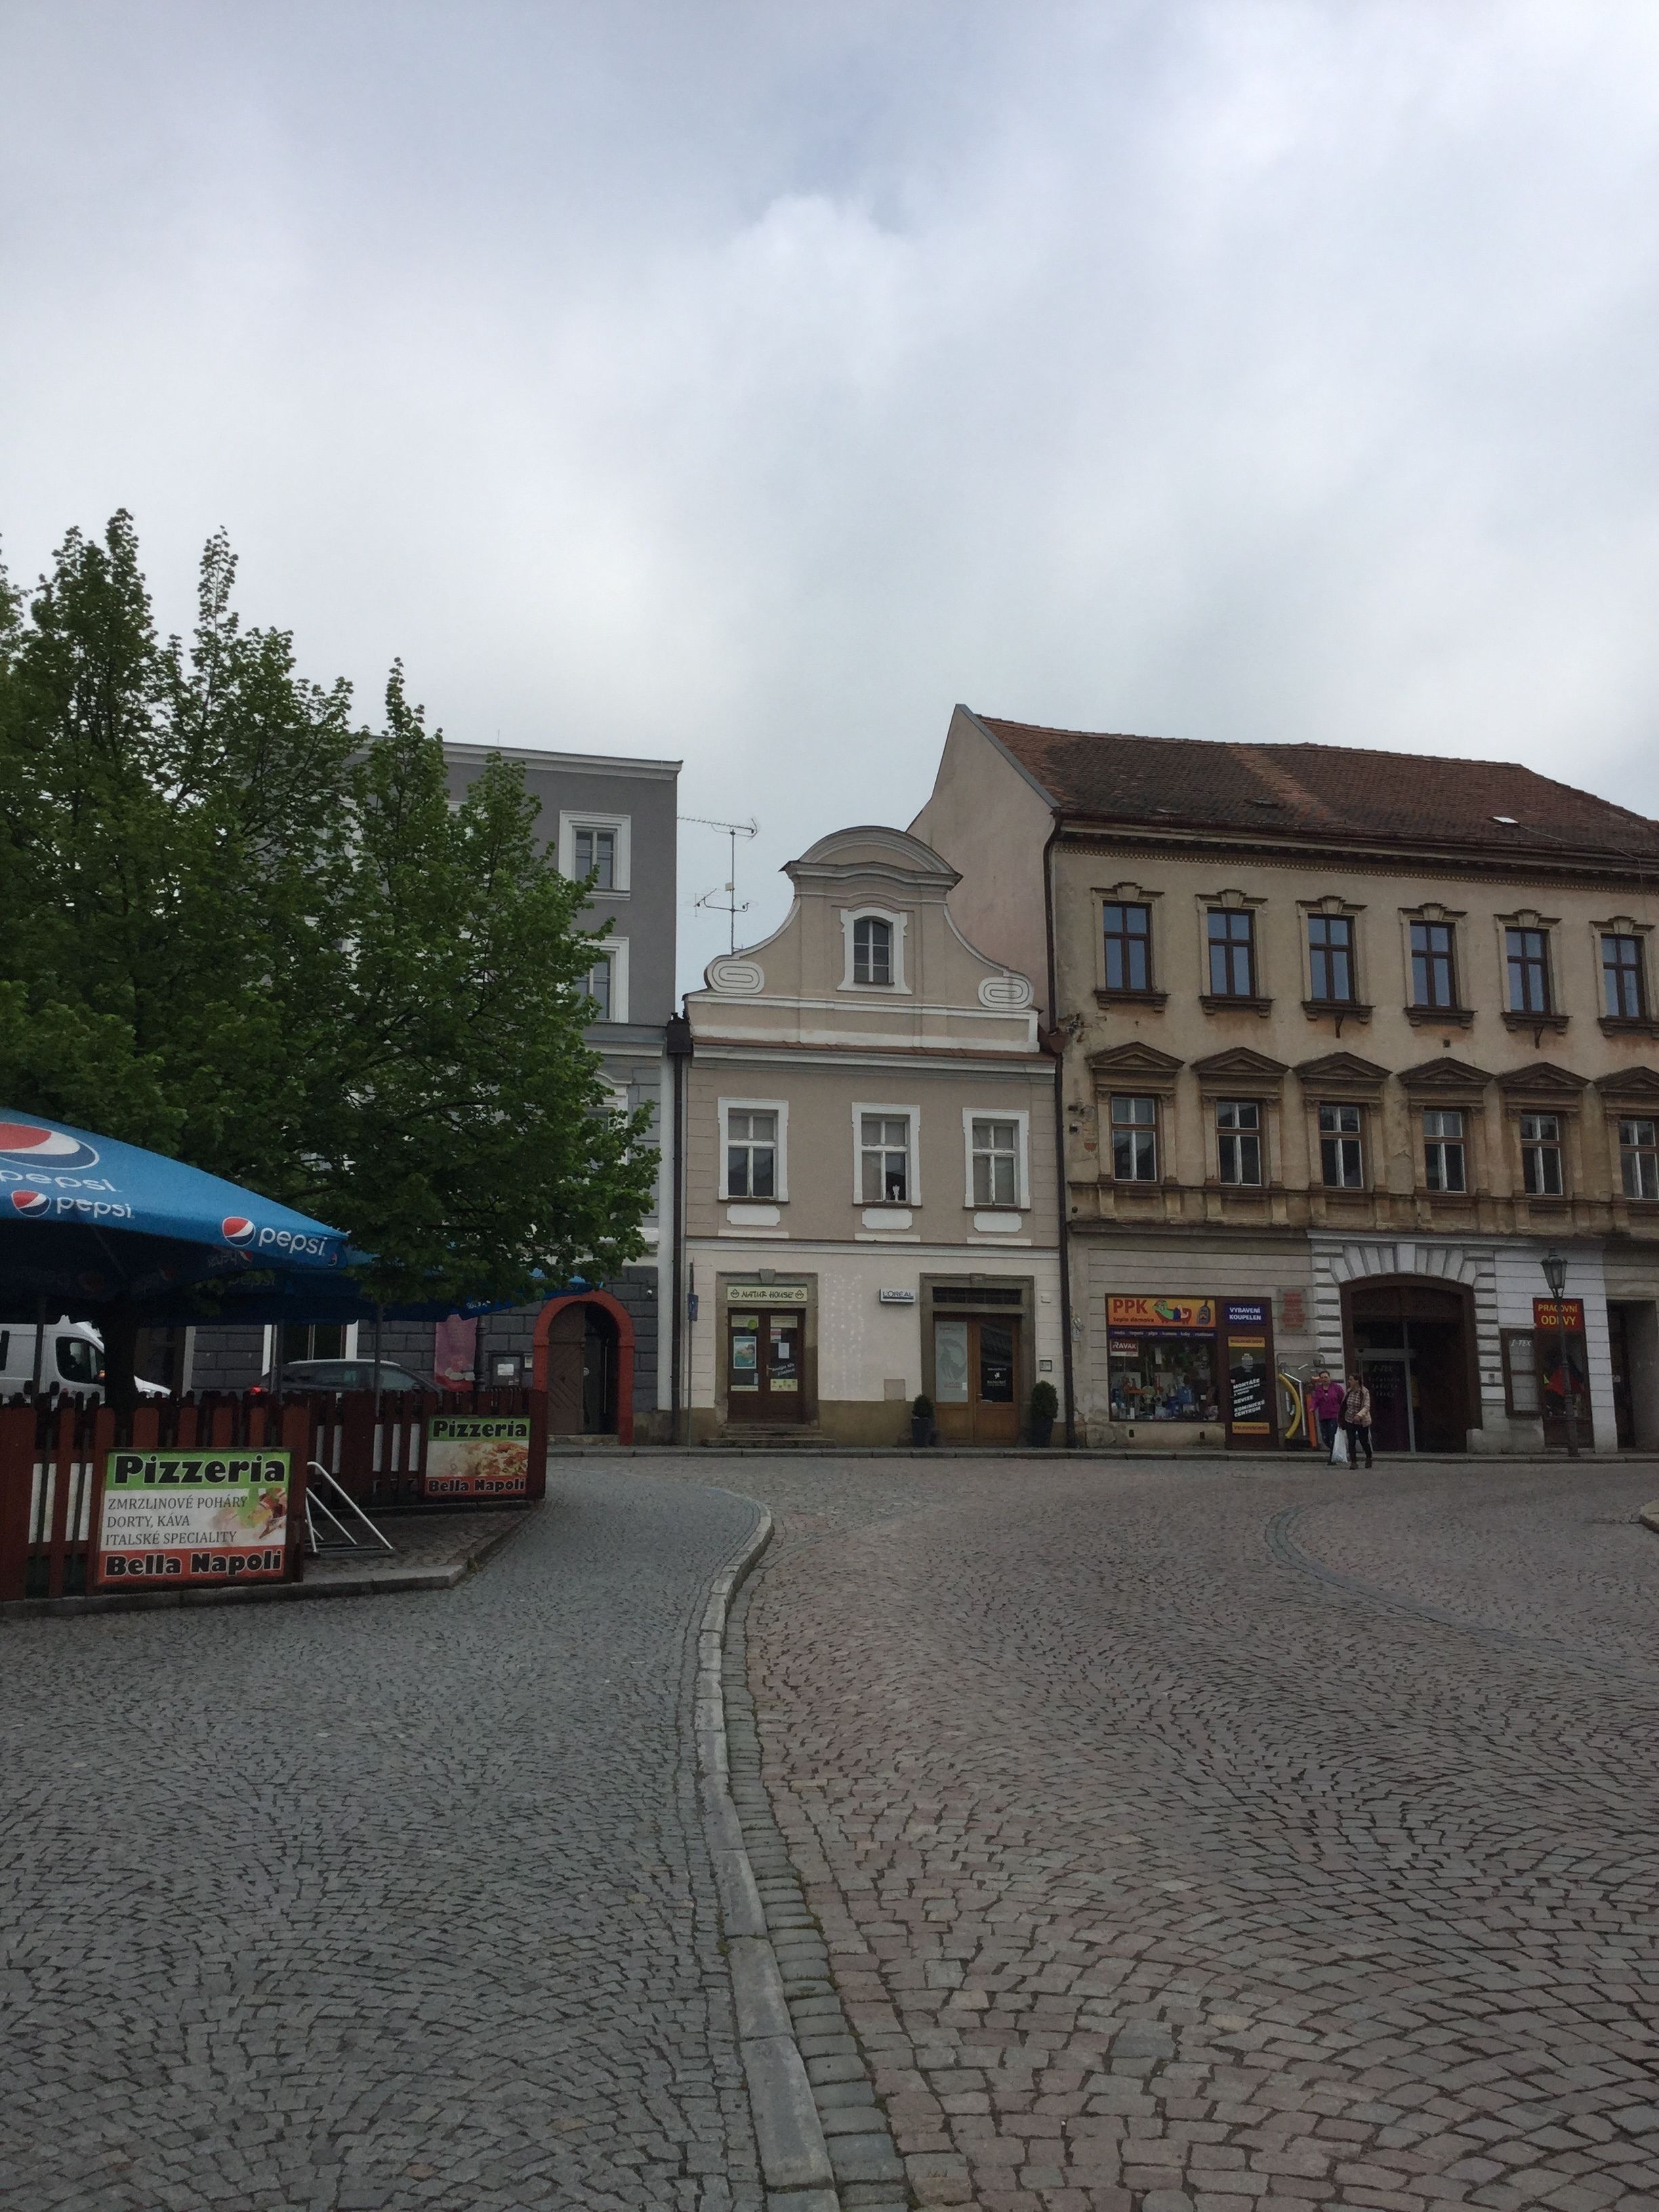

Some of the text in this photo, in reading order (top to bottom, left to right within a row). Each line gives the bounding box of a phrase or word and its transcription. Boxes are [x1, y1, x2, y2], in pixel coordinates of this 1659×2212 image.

[0, 1170, 118, 1192] pepsi
[56, 1196, 131, 1218] pepsi
[258, 1227, 328, 1256] pepsi
[741, 1290, 767, 1298] NATUR
[1113, 1299, 1148, 1314] PPK
[1112, 1341, 1137, 1349] RAVAK
[1511, 1338, 1532, 1347] I-TEX
[1233, 1378, 1260, 1389] MONTÁŽE
[1233, 1395, 1254, 1405] REVIZE
[1233, 1399, 1265, 1413] KOMINICKÉ
[1233, 1406, 1261, 1418] CENTRUM
[433, 1420, 527, 1437] Pizzeria
[115, 1455, 285, 1483] Pizzeria
[428, 1479, 525, 1492] Bella Napoli
[108, 1494, 247, 1511] ZMRZLINOVÉ POHÁRY
[107, 1513, 190, 1528] DORTY, KÁVA
[105, 1531, 237, 1546] ITALSKÉ SPECIALITY
[106, 1550, 282, 1576] Bella Napoli
